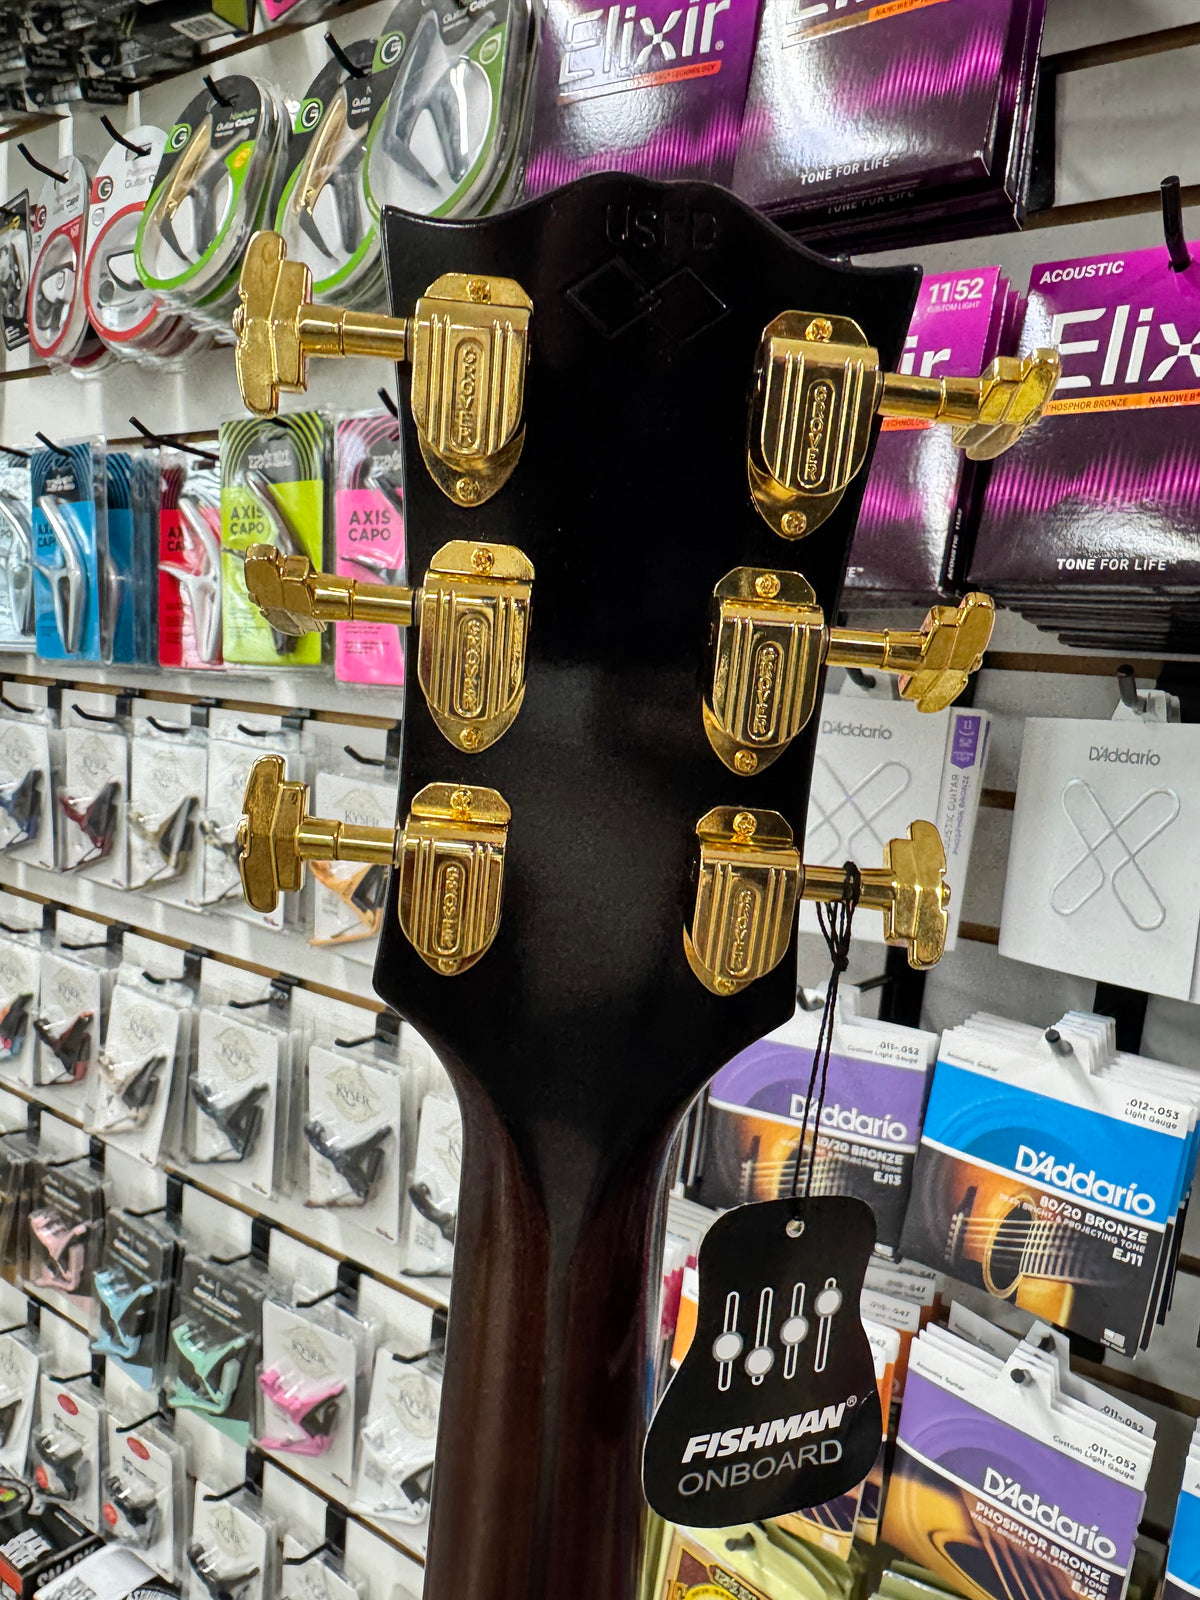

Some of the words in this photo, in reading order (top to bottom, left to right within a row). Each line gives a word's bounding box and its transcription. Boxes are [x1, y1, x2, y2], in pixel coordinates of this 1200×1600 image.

[801, 168, 832, 185] TONE
[835, 162, 860, 178] FOR
[1039, 260, 1124, 285] ACOUSTIC
[959, 300, 981, 311] LIGHT
[461, 345, 477, 448] GROVER
[1045, 401, 1091, 413] PHOSPHOR
[1093, 397, 1129, 408] BRONZE
[804, 385, 828, 481] GROVER
[231, 505, 265, 520] AXIS
[349, 510, 391, 526] AXIS
[230, 522, 265, 535] CAPO
[348, 528, 391, 542] CAPO
[1056, 558, 1096, 571] TONE
[1100, 558, 1130, 571] FOR
[463, 620, 481, 711] GROVER
[752, 647, 775, 735] GROVER
[821, 720, 893, 740] D'Addario
[1088, 746, 1161, 766] D'Addario
[441, 866, 459, 949] GROVER
[729, 889, 752, 970] GROVER
[789, 1093, 908, 1142] D'Addario
[1124, 1108, 1147, 1122] Light
[1148, 1116, 1179, 1130] Gauge
[1126, 1098, 1181, 1121] .012-.053
[850, 1144, 905, 1166] BRONZE
[1014, 1144, 1156, 1217] D'Addario
[1039, 1195, 1083, 1221] 80/20
[1084, 1212, 1150, 1245] BRONZE
[1062, 1217, 1118, 1245] PROJECTING
[1120, 1238, 1147, 1254] TONE
[1111, 1247, 1144, 1268] EJ11
[678, 1440, 844, 1496] ONBOARD
[1052, 1434, 1083, 1455] Custom
[1084, 1450, 1106, 1467] Light
[1107, 1463, 1135, 1481] Gauge
[1088, 1443, 1137, 1473] .011-.052
[983, 1466, 1117, 1560] D'Addario
[976, 1501, 1048, 1550] PHOSPHOR
[1050, 1545, 1110, 1585] BRONZE
[1083, 1575, 1109, 1594] TONE
